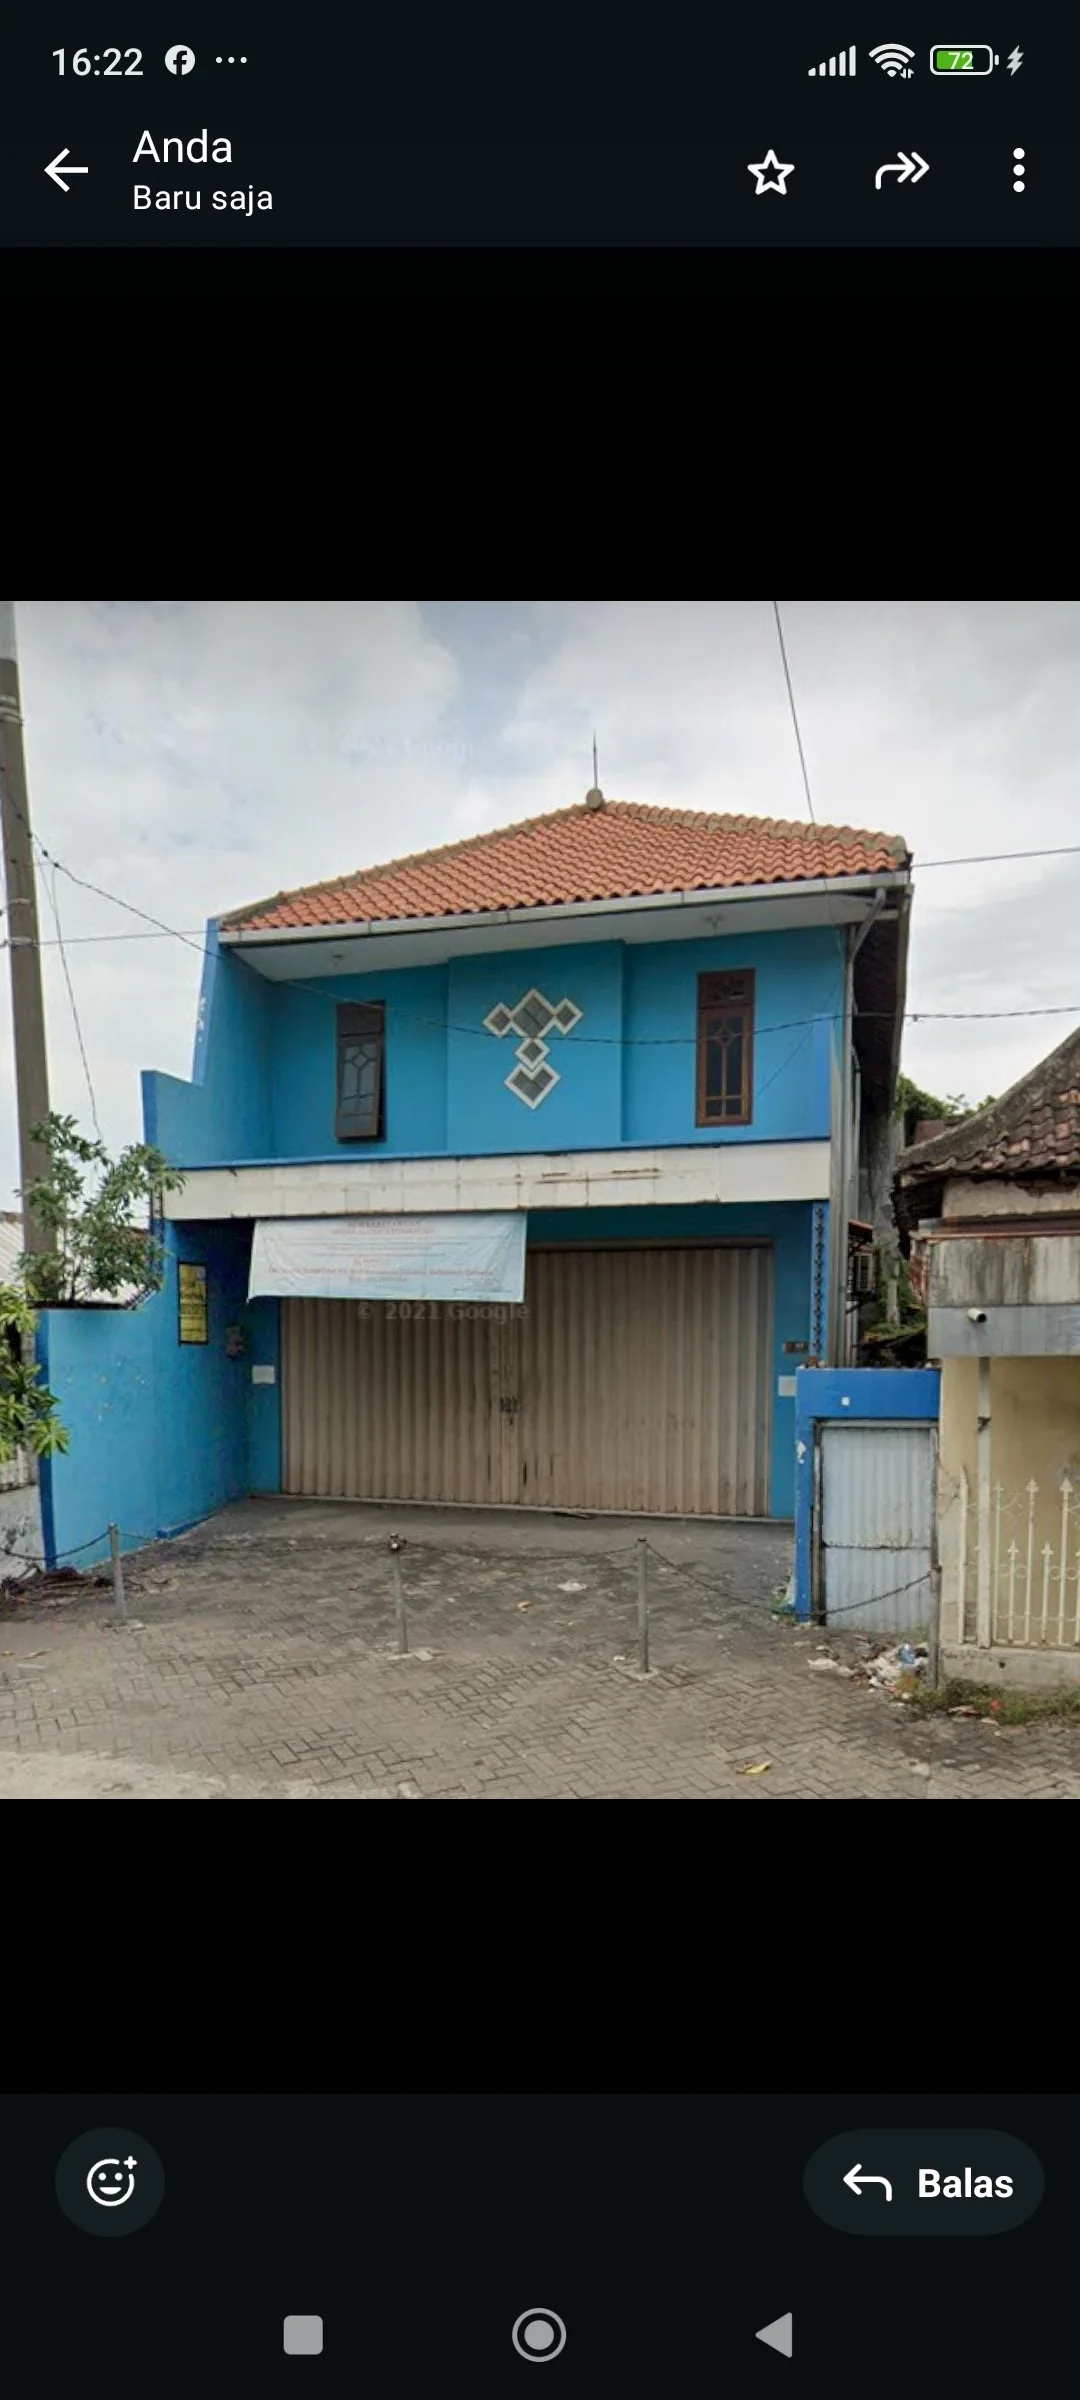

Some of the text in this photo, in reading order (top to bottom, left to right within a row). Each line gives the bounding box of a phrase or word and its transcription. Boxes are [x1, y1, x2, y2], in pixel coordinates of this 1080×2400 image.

[53, 48, 143, 76] 16:22
[948, 52, 974, 69] 72
[132, 129, 232, 163] Anda
[134, 185, 272, 216] Baru saja
[919, 2167, 1013, 2198] Balas
